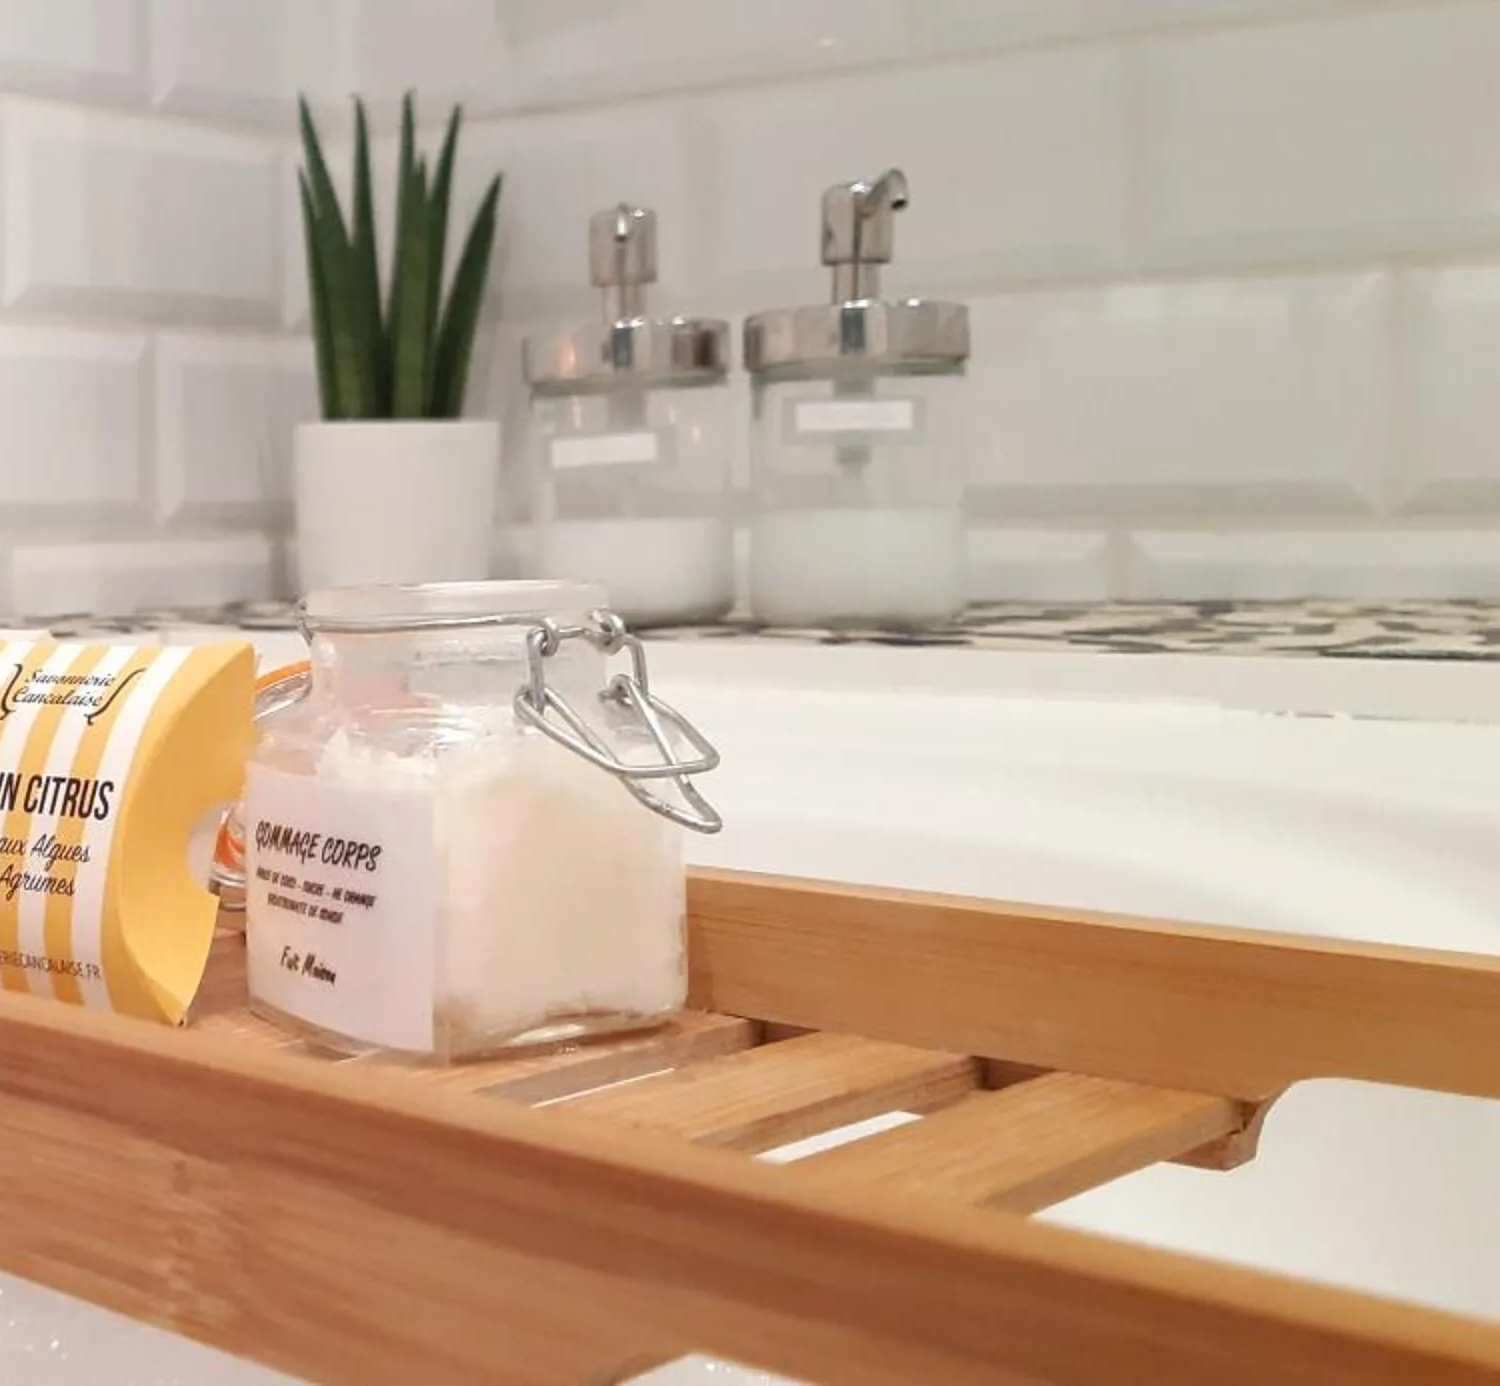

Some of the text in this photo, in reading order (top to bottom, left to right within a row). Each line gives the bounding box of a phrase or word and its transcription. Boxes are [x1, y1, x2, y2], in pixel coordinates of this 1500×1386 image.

[11, 686, 103, 706] Cancalaise
[24, 669, 116, 686] Savonnerie
[23, 775, 115, 820] CITRUS
[30, 833, 92, 871] Algues
[255, 820, 382, 872] GOMMAGE CORPS
